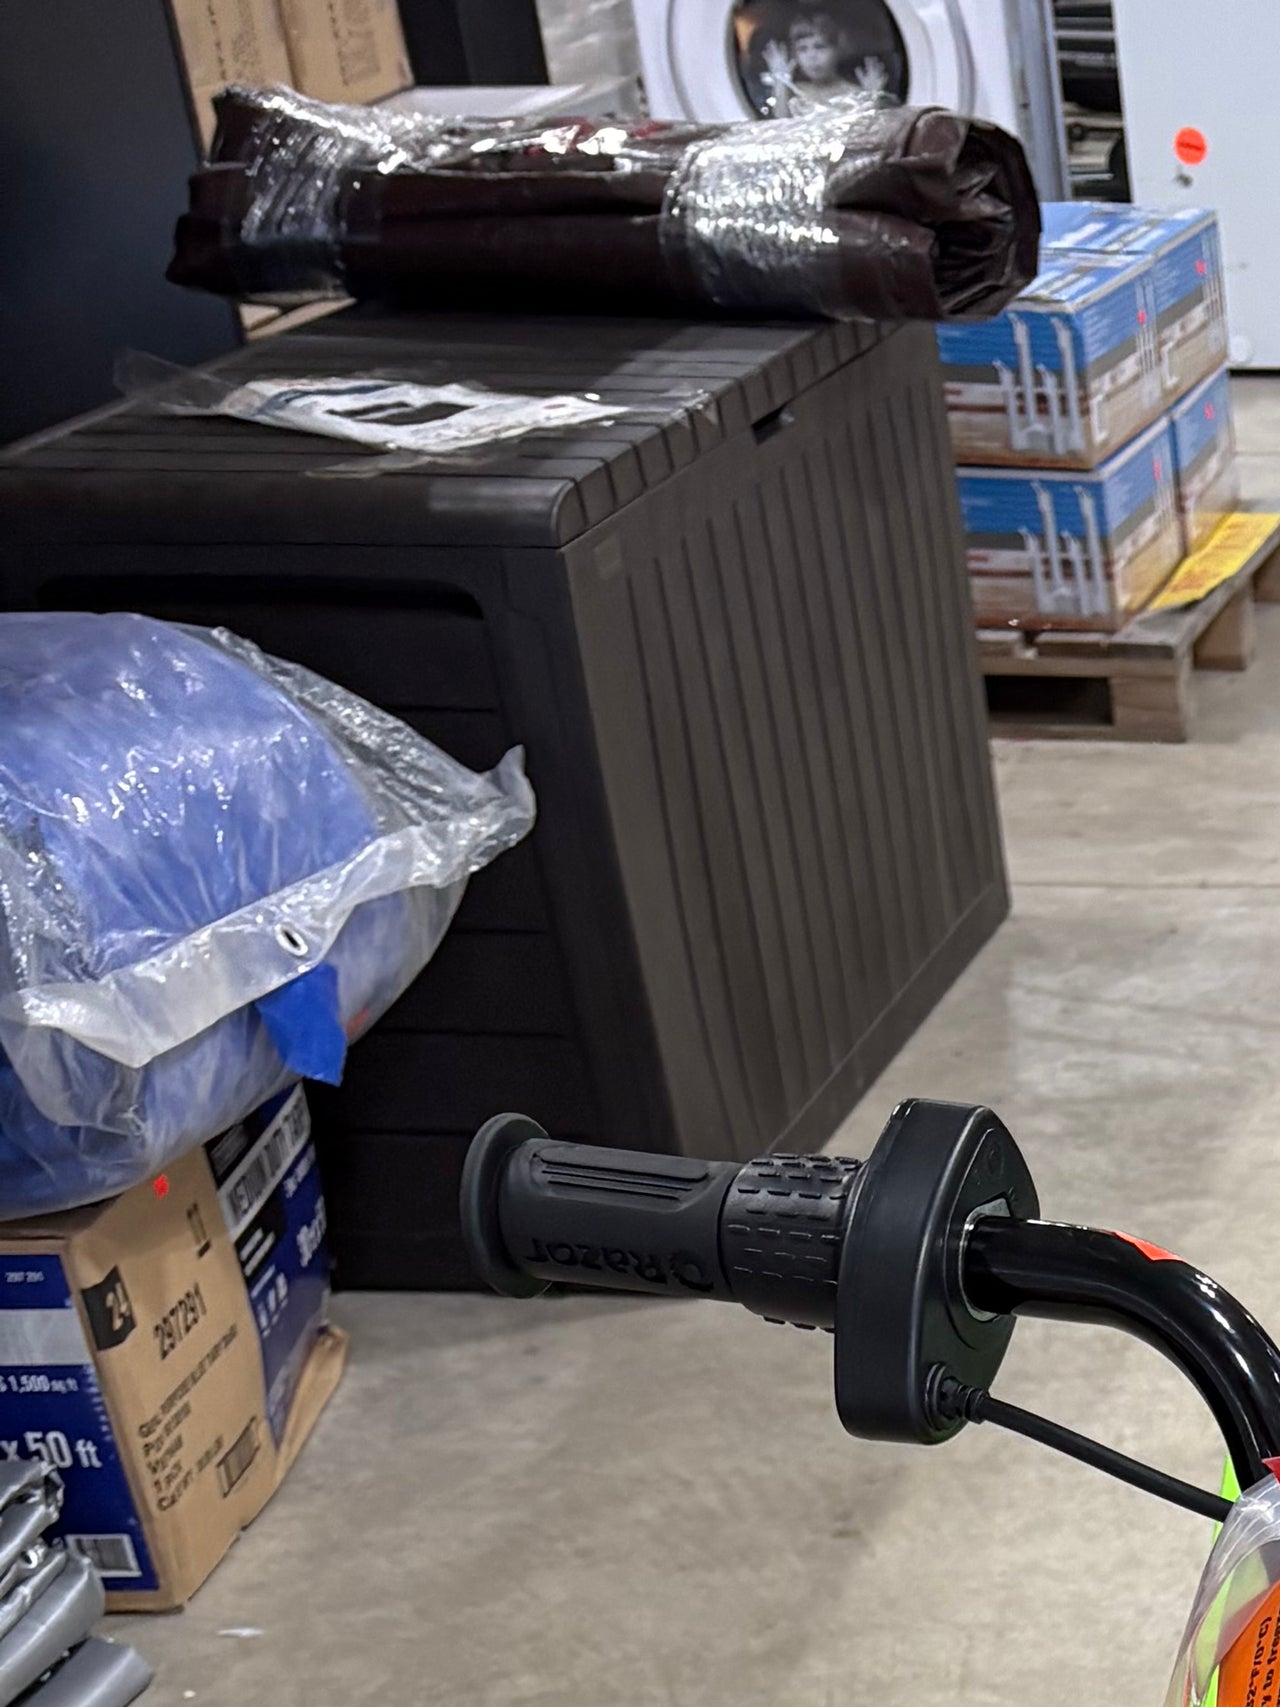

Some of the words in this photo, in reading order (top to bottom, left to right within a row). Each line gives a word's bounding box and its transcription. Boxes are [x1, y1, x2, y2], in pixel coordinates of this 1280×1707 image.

[24, 1431, 73, 1468] 50
[75, 1439, 103, 1468] ft
[1262, 1668, 1275, 1691] to
